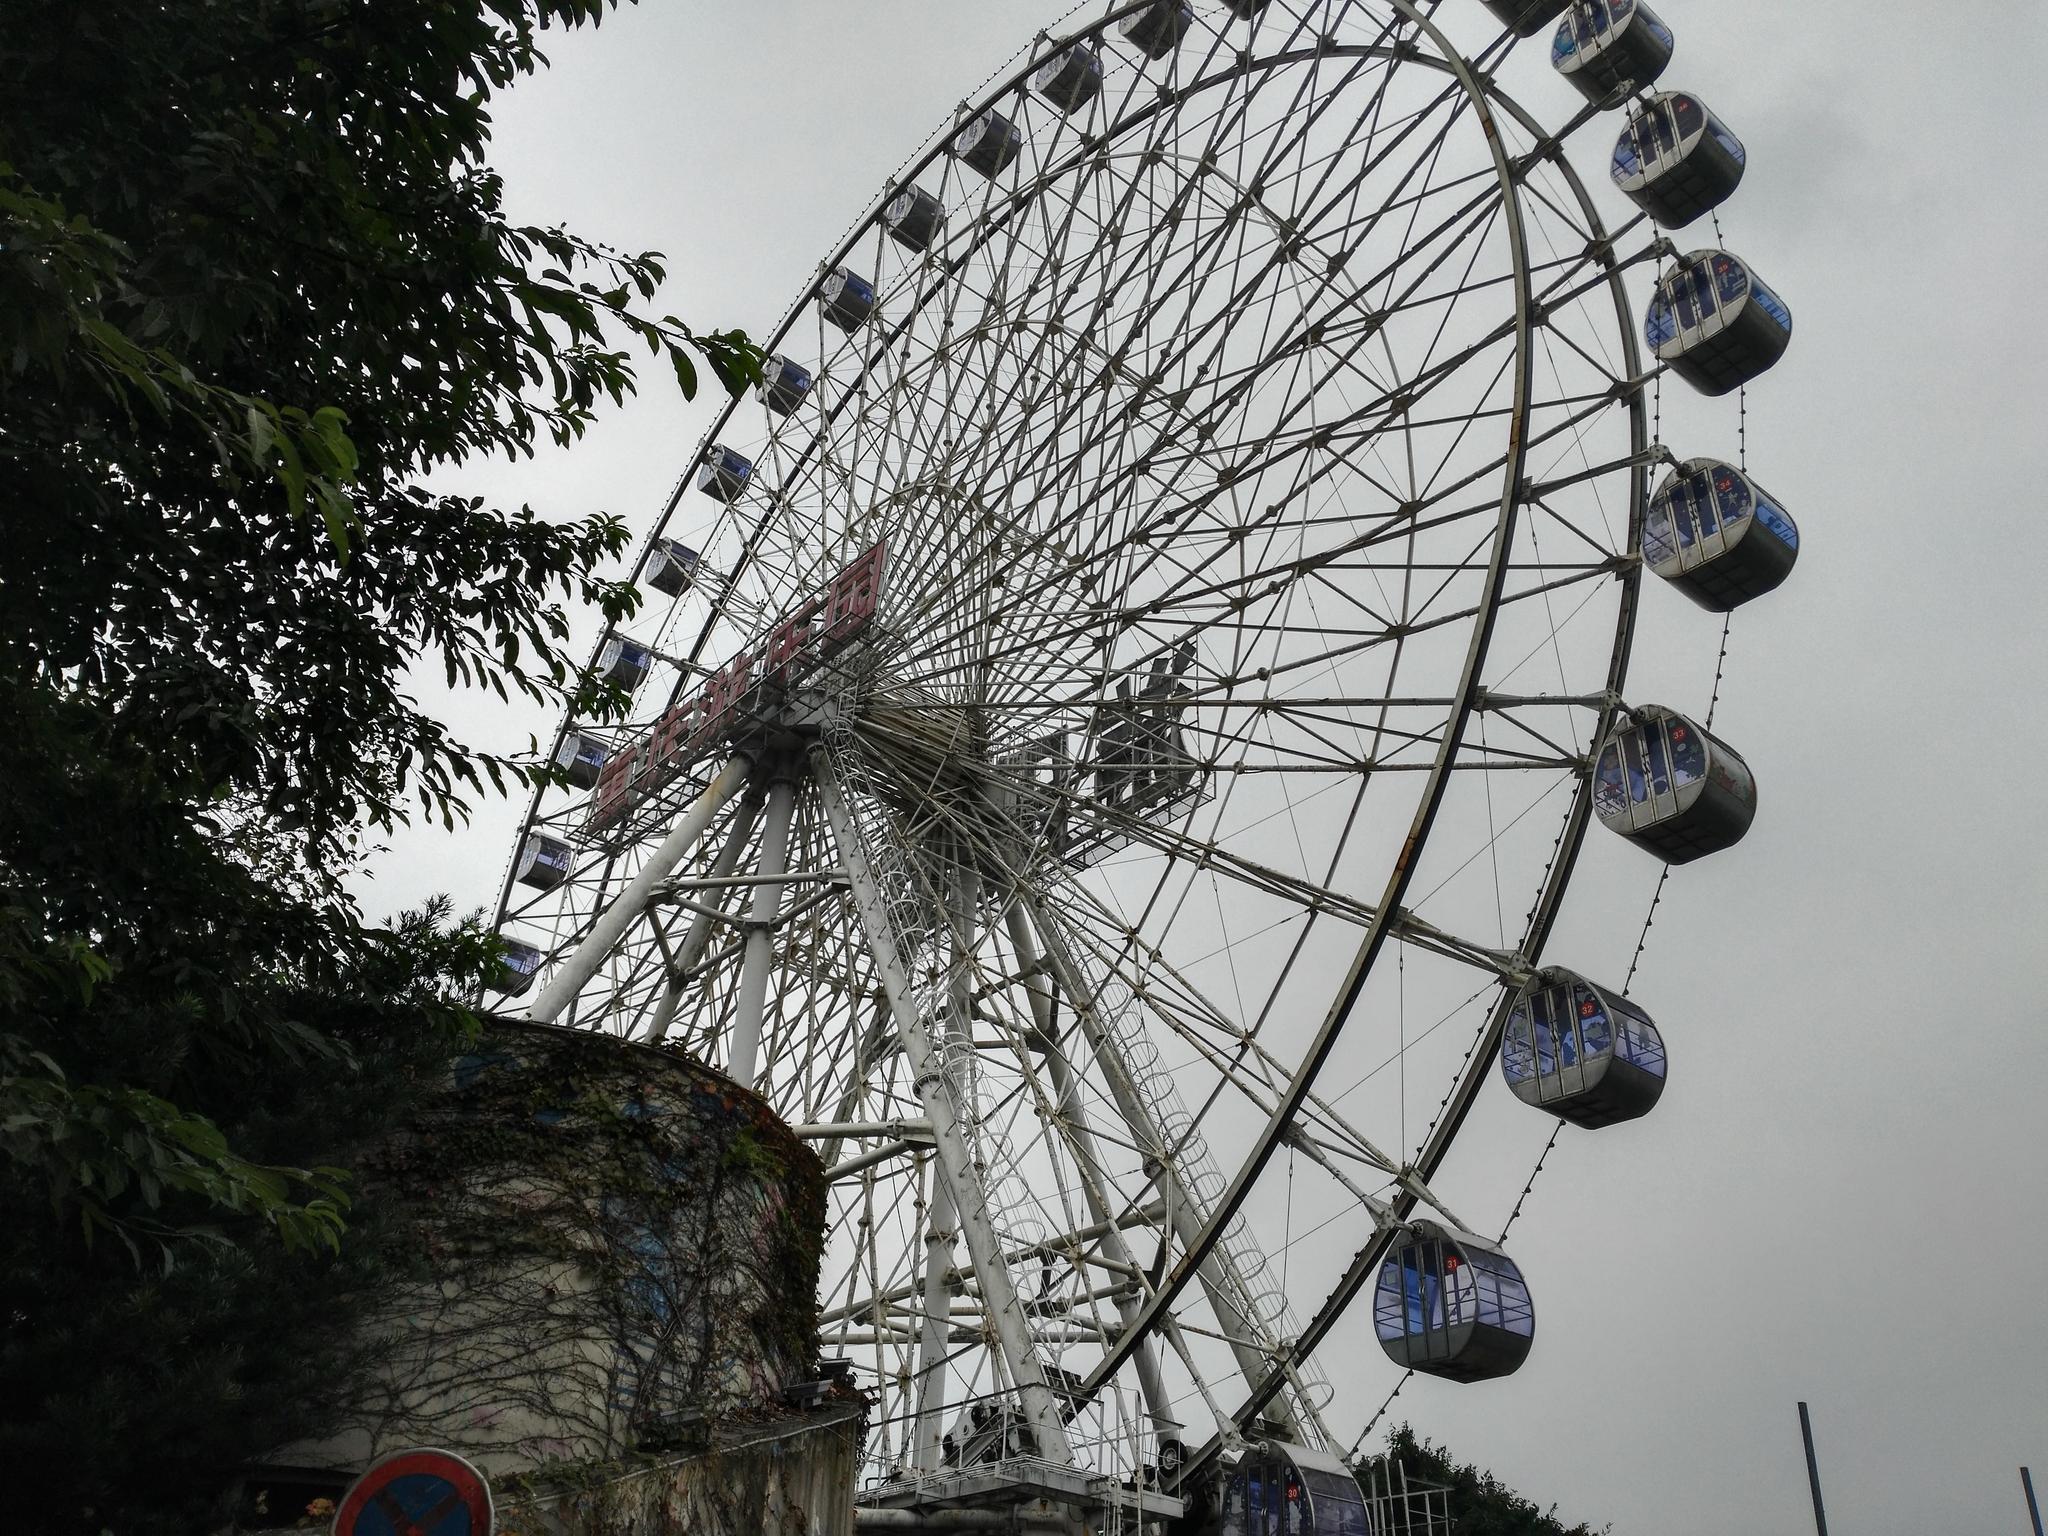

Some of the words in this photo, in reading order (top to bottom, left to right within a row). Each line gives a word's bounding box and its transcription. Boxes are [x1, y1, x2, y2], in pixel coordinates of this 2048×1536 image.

[1673, 730, 1685, 739] 33
[1582, 1005, 1593, 1014] 32
[1447, 1259, 1457, 1268] 31
[1288, 1489, 1298, 1498] 30
